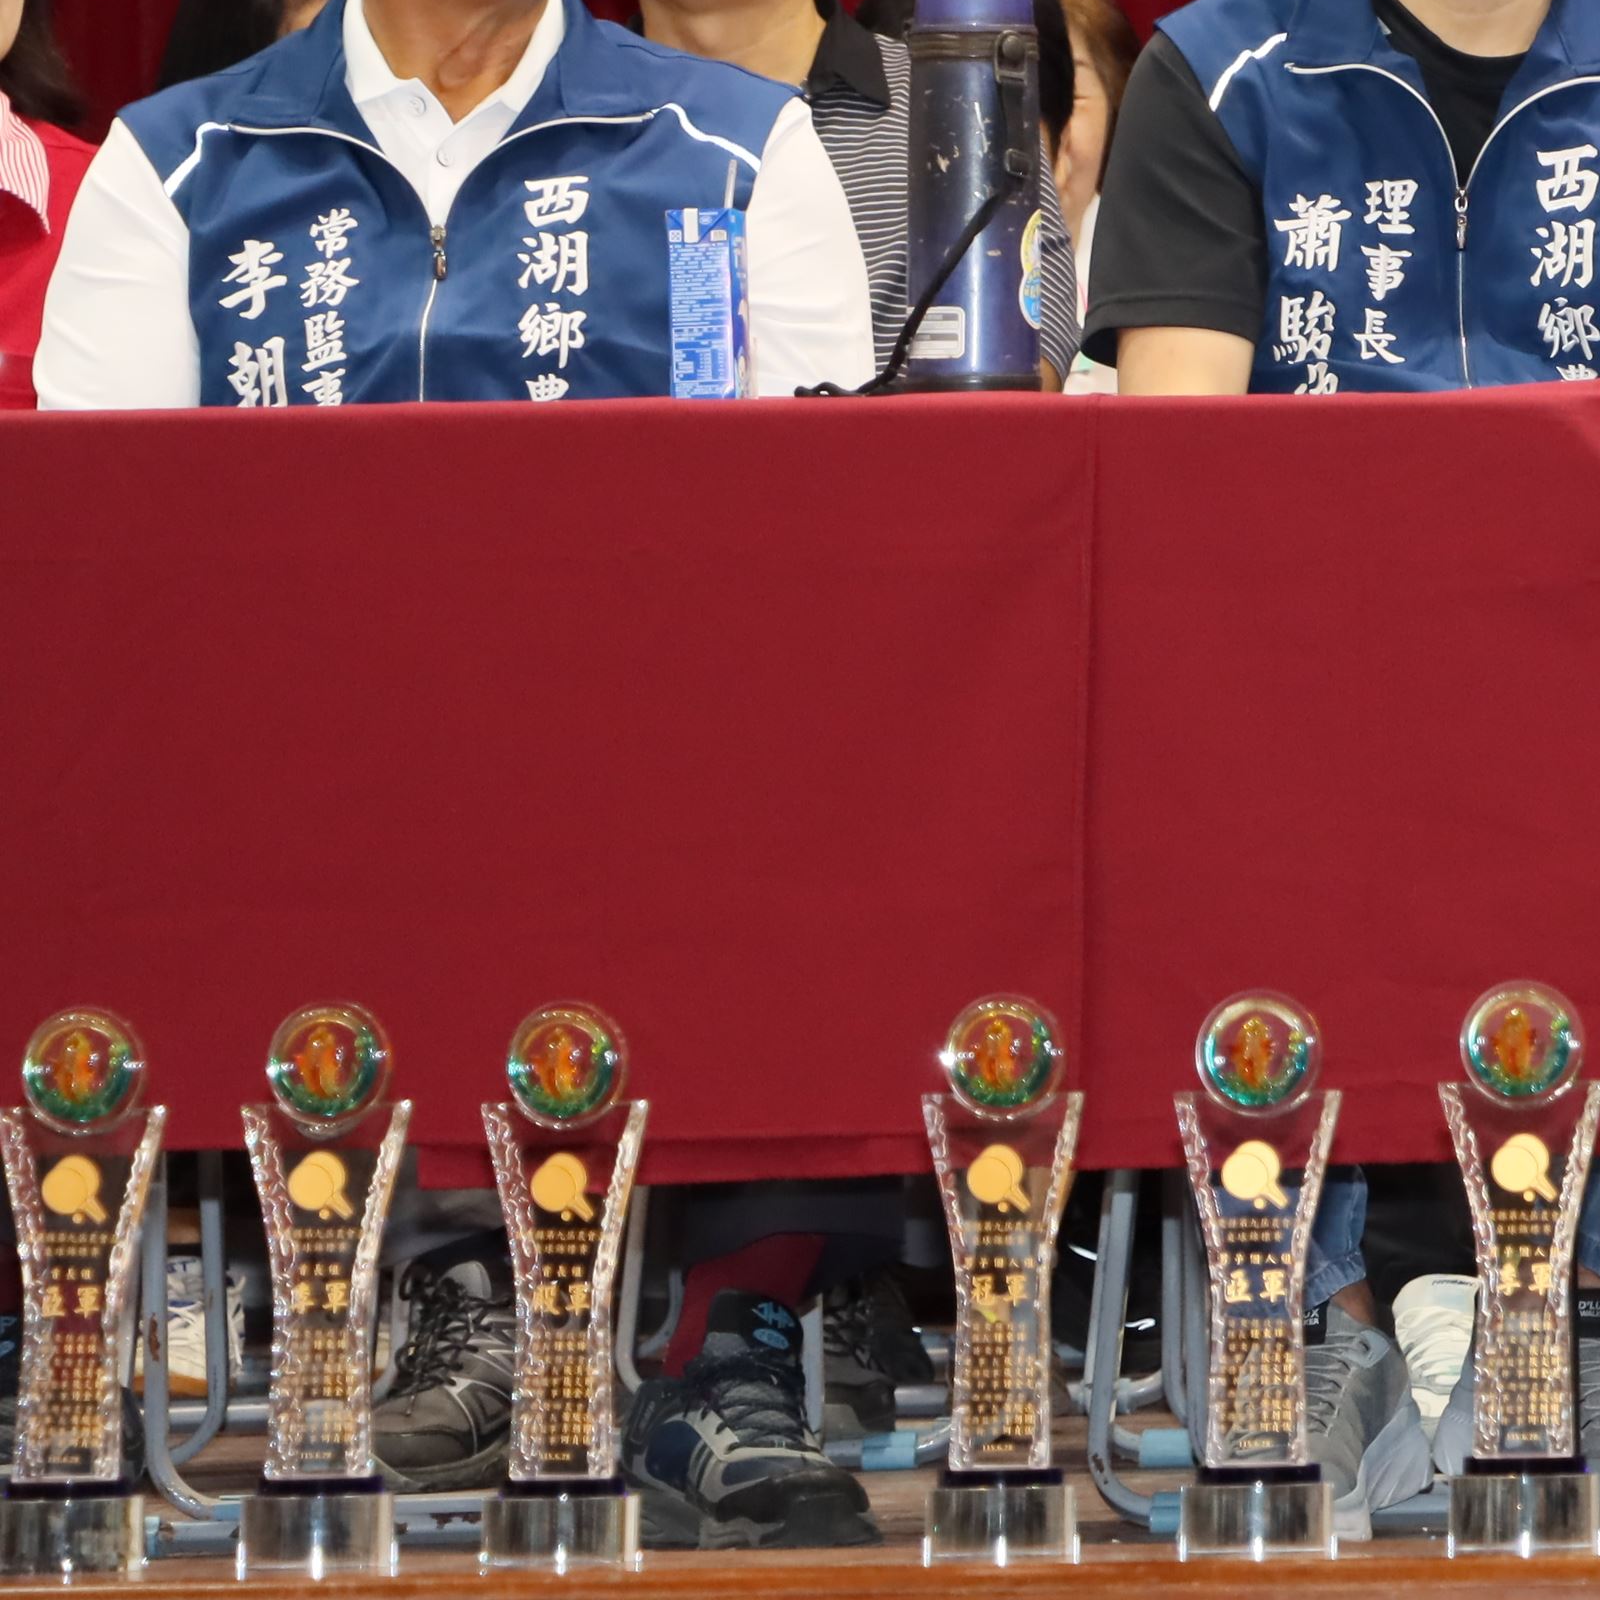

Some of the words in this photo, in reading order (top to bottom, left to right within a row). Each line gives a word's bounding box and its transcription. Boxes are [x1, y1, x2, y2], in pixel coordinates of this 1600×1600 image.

[300, 208, 359, 407] 常務監事
[1353, 179, 1419, 364] 理事長
[1530, 144, 1600, 382] 西湖鄉
[971, 1274, 1029, 1307] 冠軍
[1224, 1269, 1286, 1303] 亞軍
[1499, 1262, 1553, 1296] 季軍
